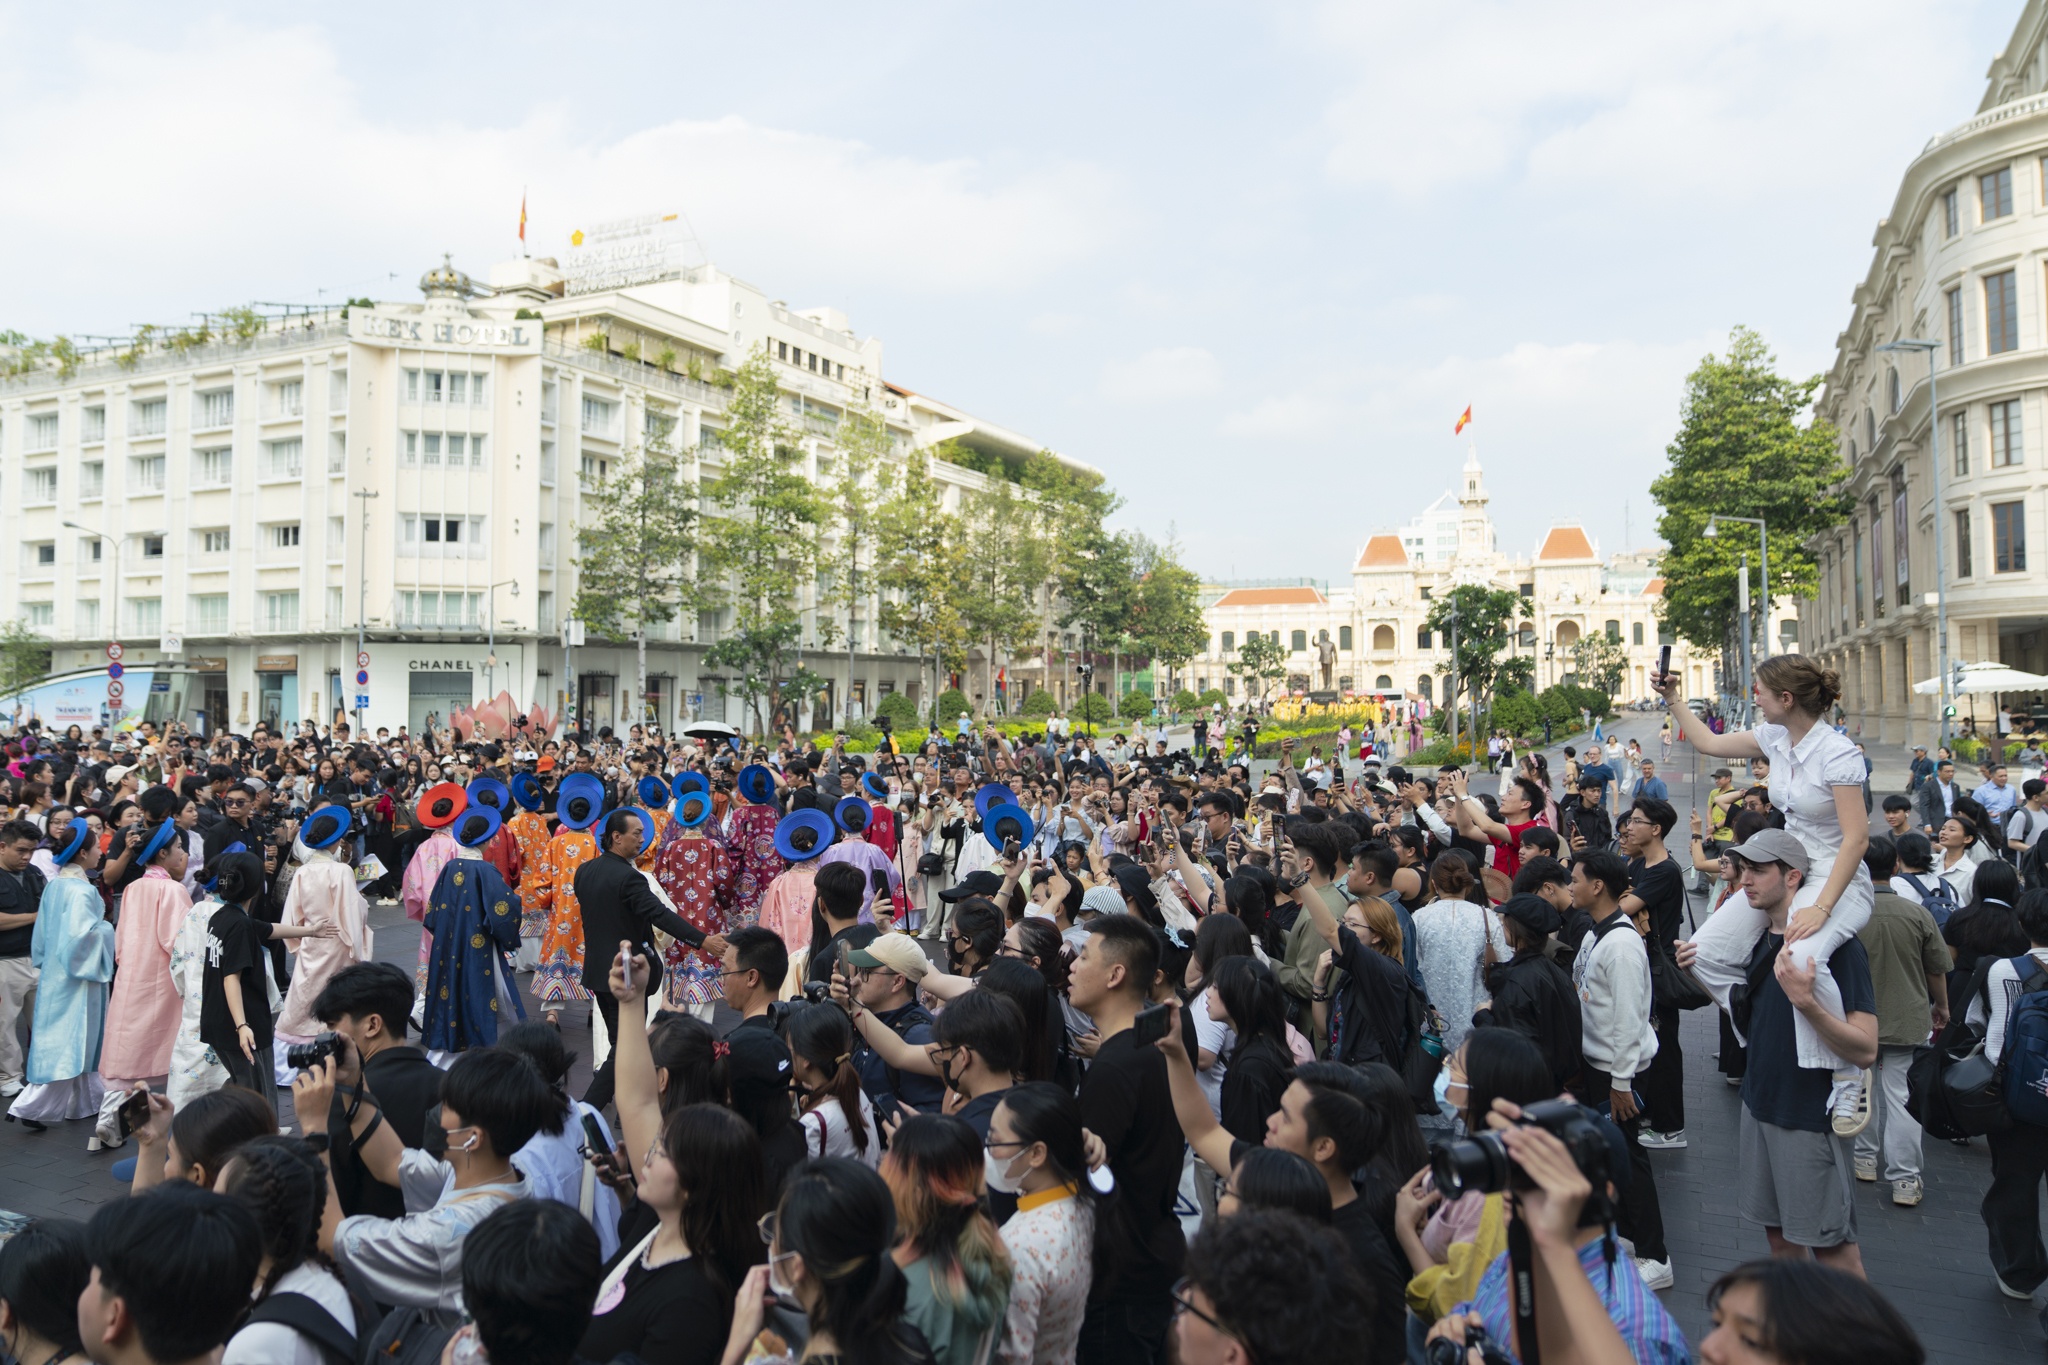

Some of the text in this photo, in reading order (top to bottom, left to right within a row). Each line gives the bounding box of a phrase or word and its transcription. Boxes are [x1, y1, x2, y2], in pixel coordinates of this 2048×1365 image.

[363, 314, 530, 346] REX HOTEL
[409, 660, 474, 670] CHANEL
